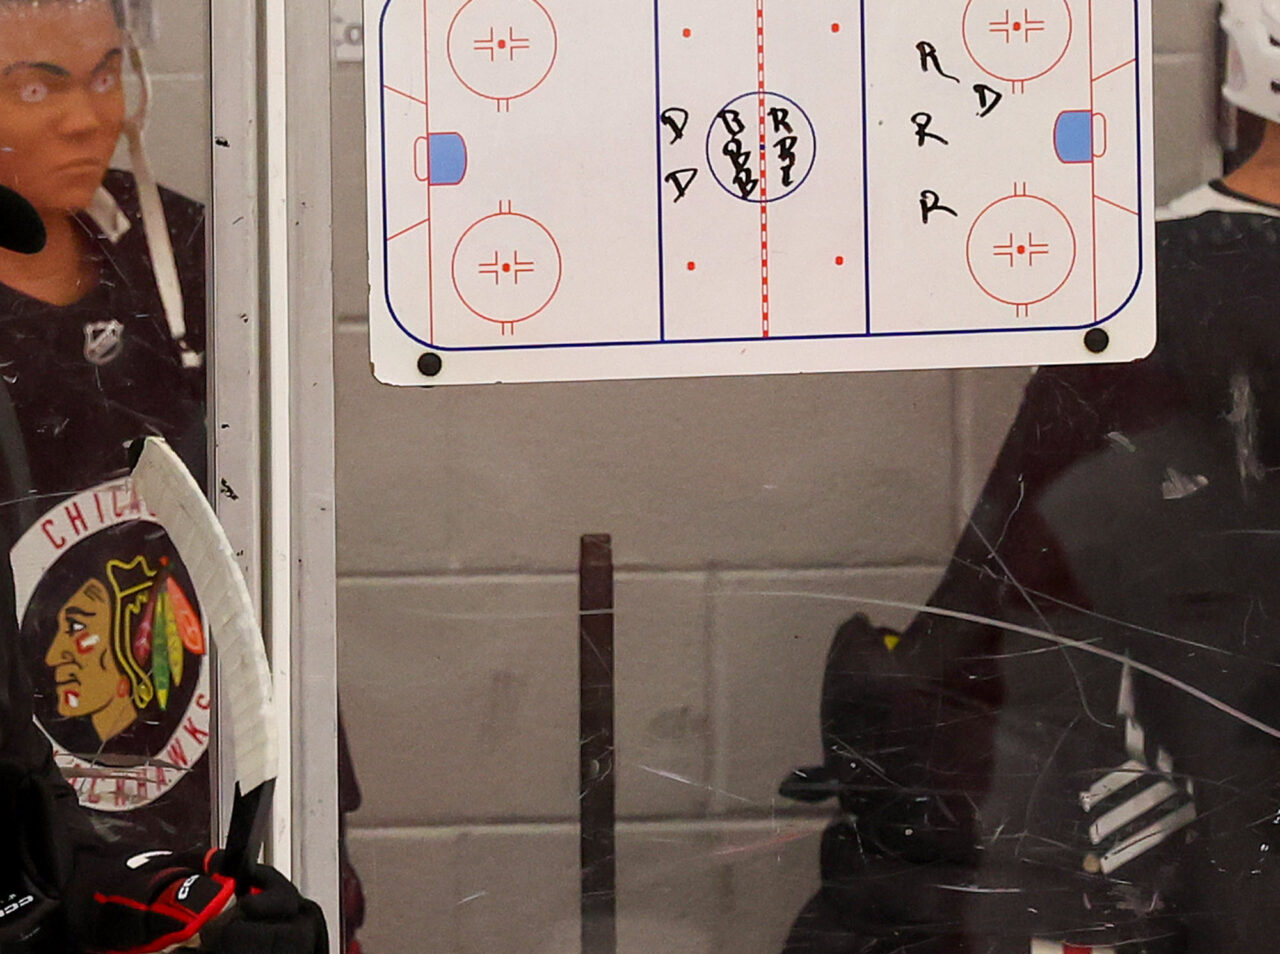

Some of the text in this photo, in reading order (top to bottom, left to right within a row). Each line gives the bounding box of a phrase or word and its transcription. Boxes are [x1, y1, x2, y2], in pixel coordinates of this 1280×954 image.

[916, 41, 960, 83] R
[767, 107, 793, 134] R
[911, 112, 948, 147] R
[919, 189, 958, 224] R
